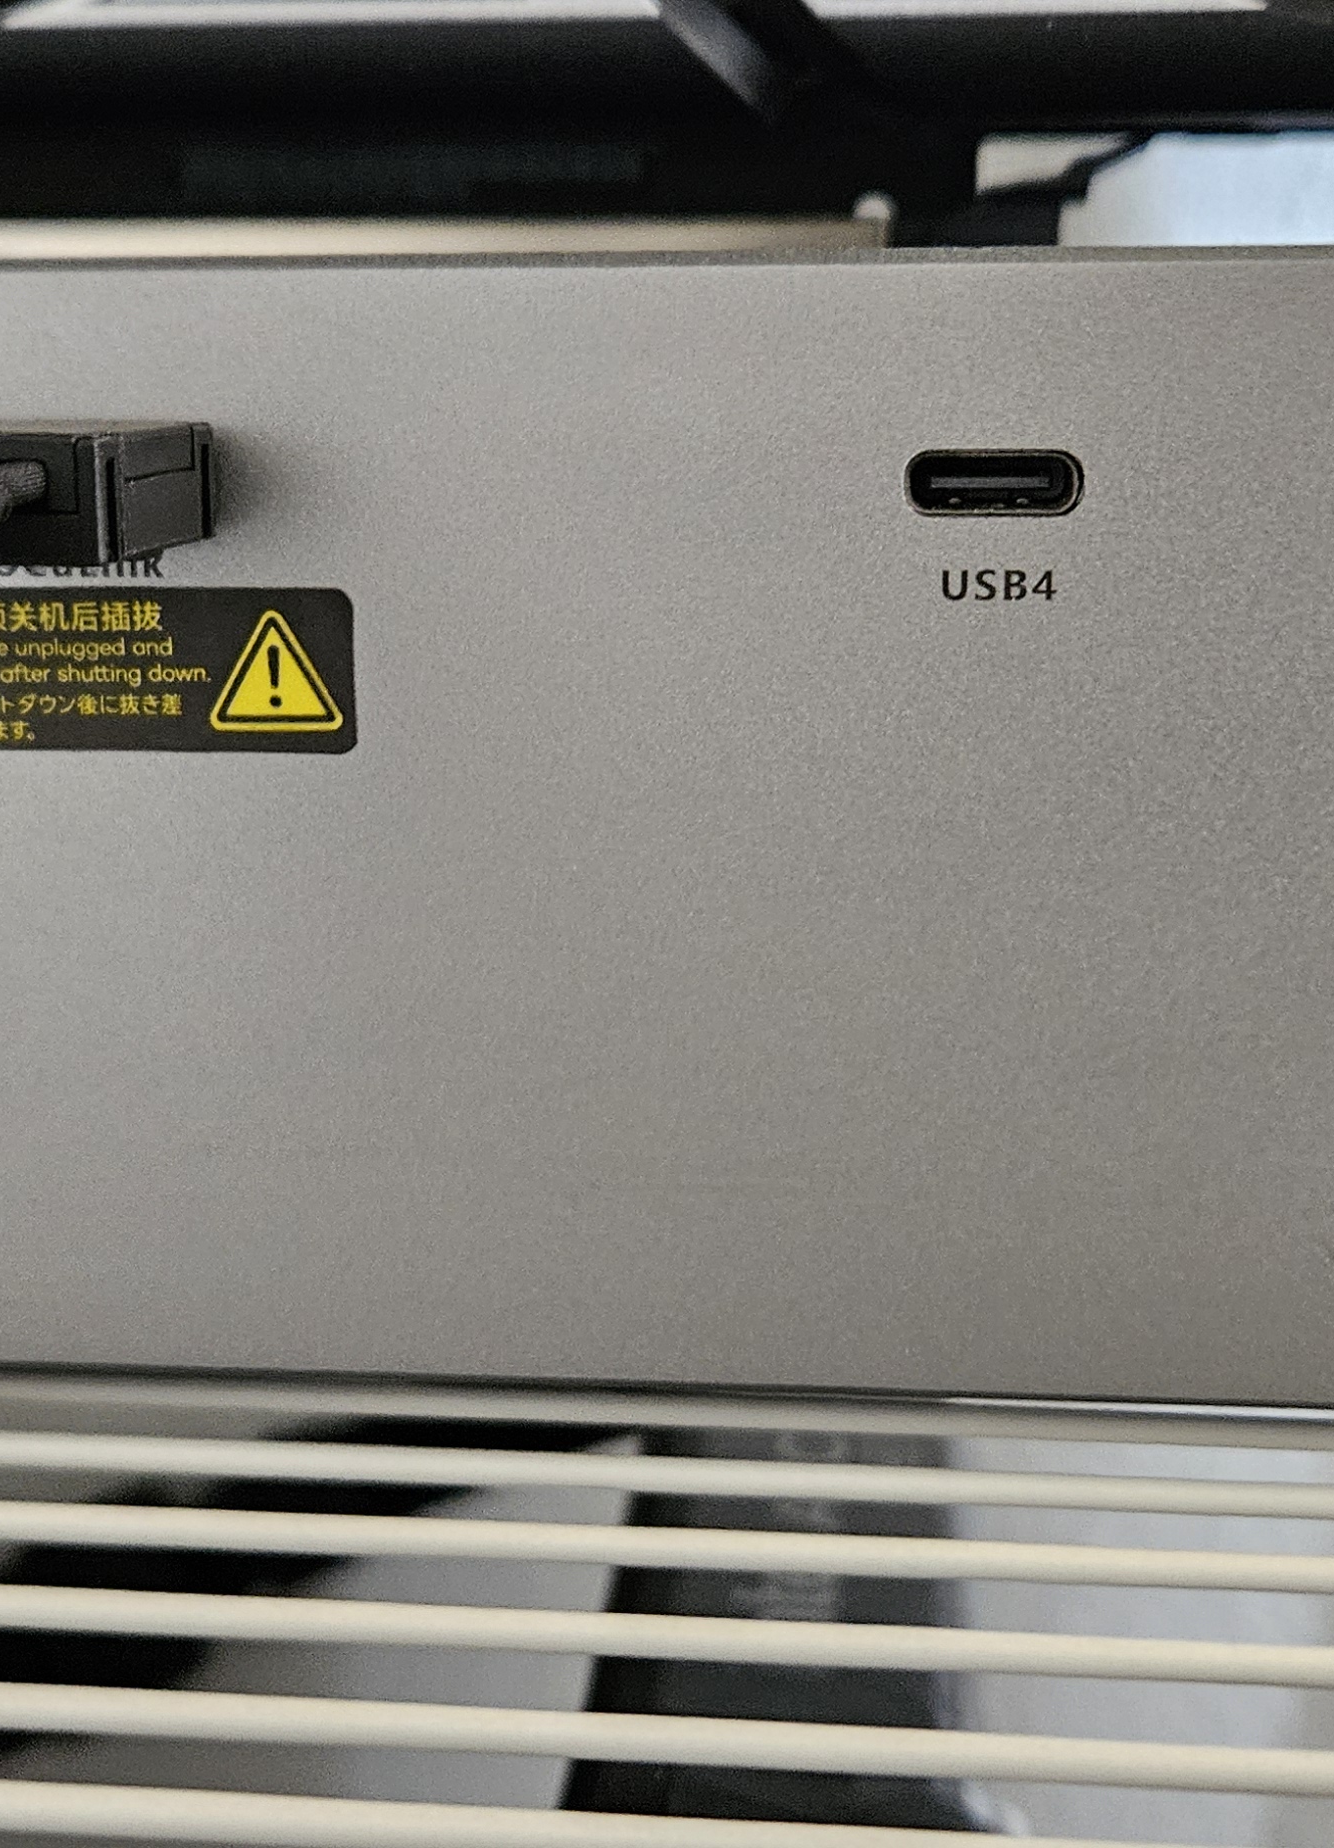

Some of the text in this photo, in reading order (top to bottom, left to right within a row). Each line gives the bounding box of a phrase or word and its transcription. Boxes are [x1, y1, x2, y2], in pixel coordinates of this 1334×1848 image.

[941, 569, 1058, 601] USB4
[15, 637, 126, 662] unplugged
[132, 636, 173, 657] and
[0, 663, 51, 683] after
[57, 664, 142, 688] shutting
[148, 664, 212, 683] down.
